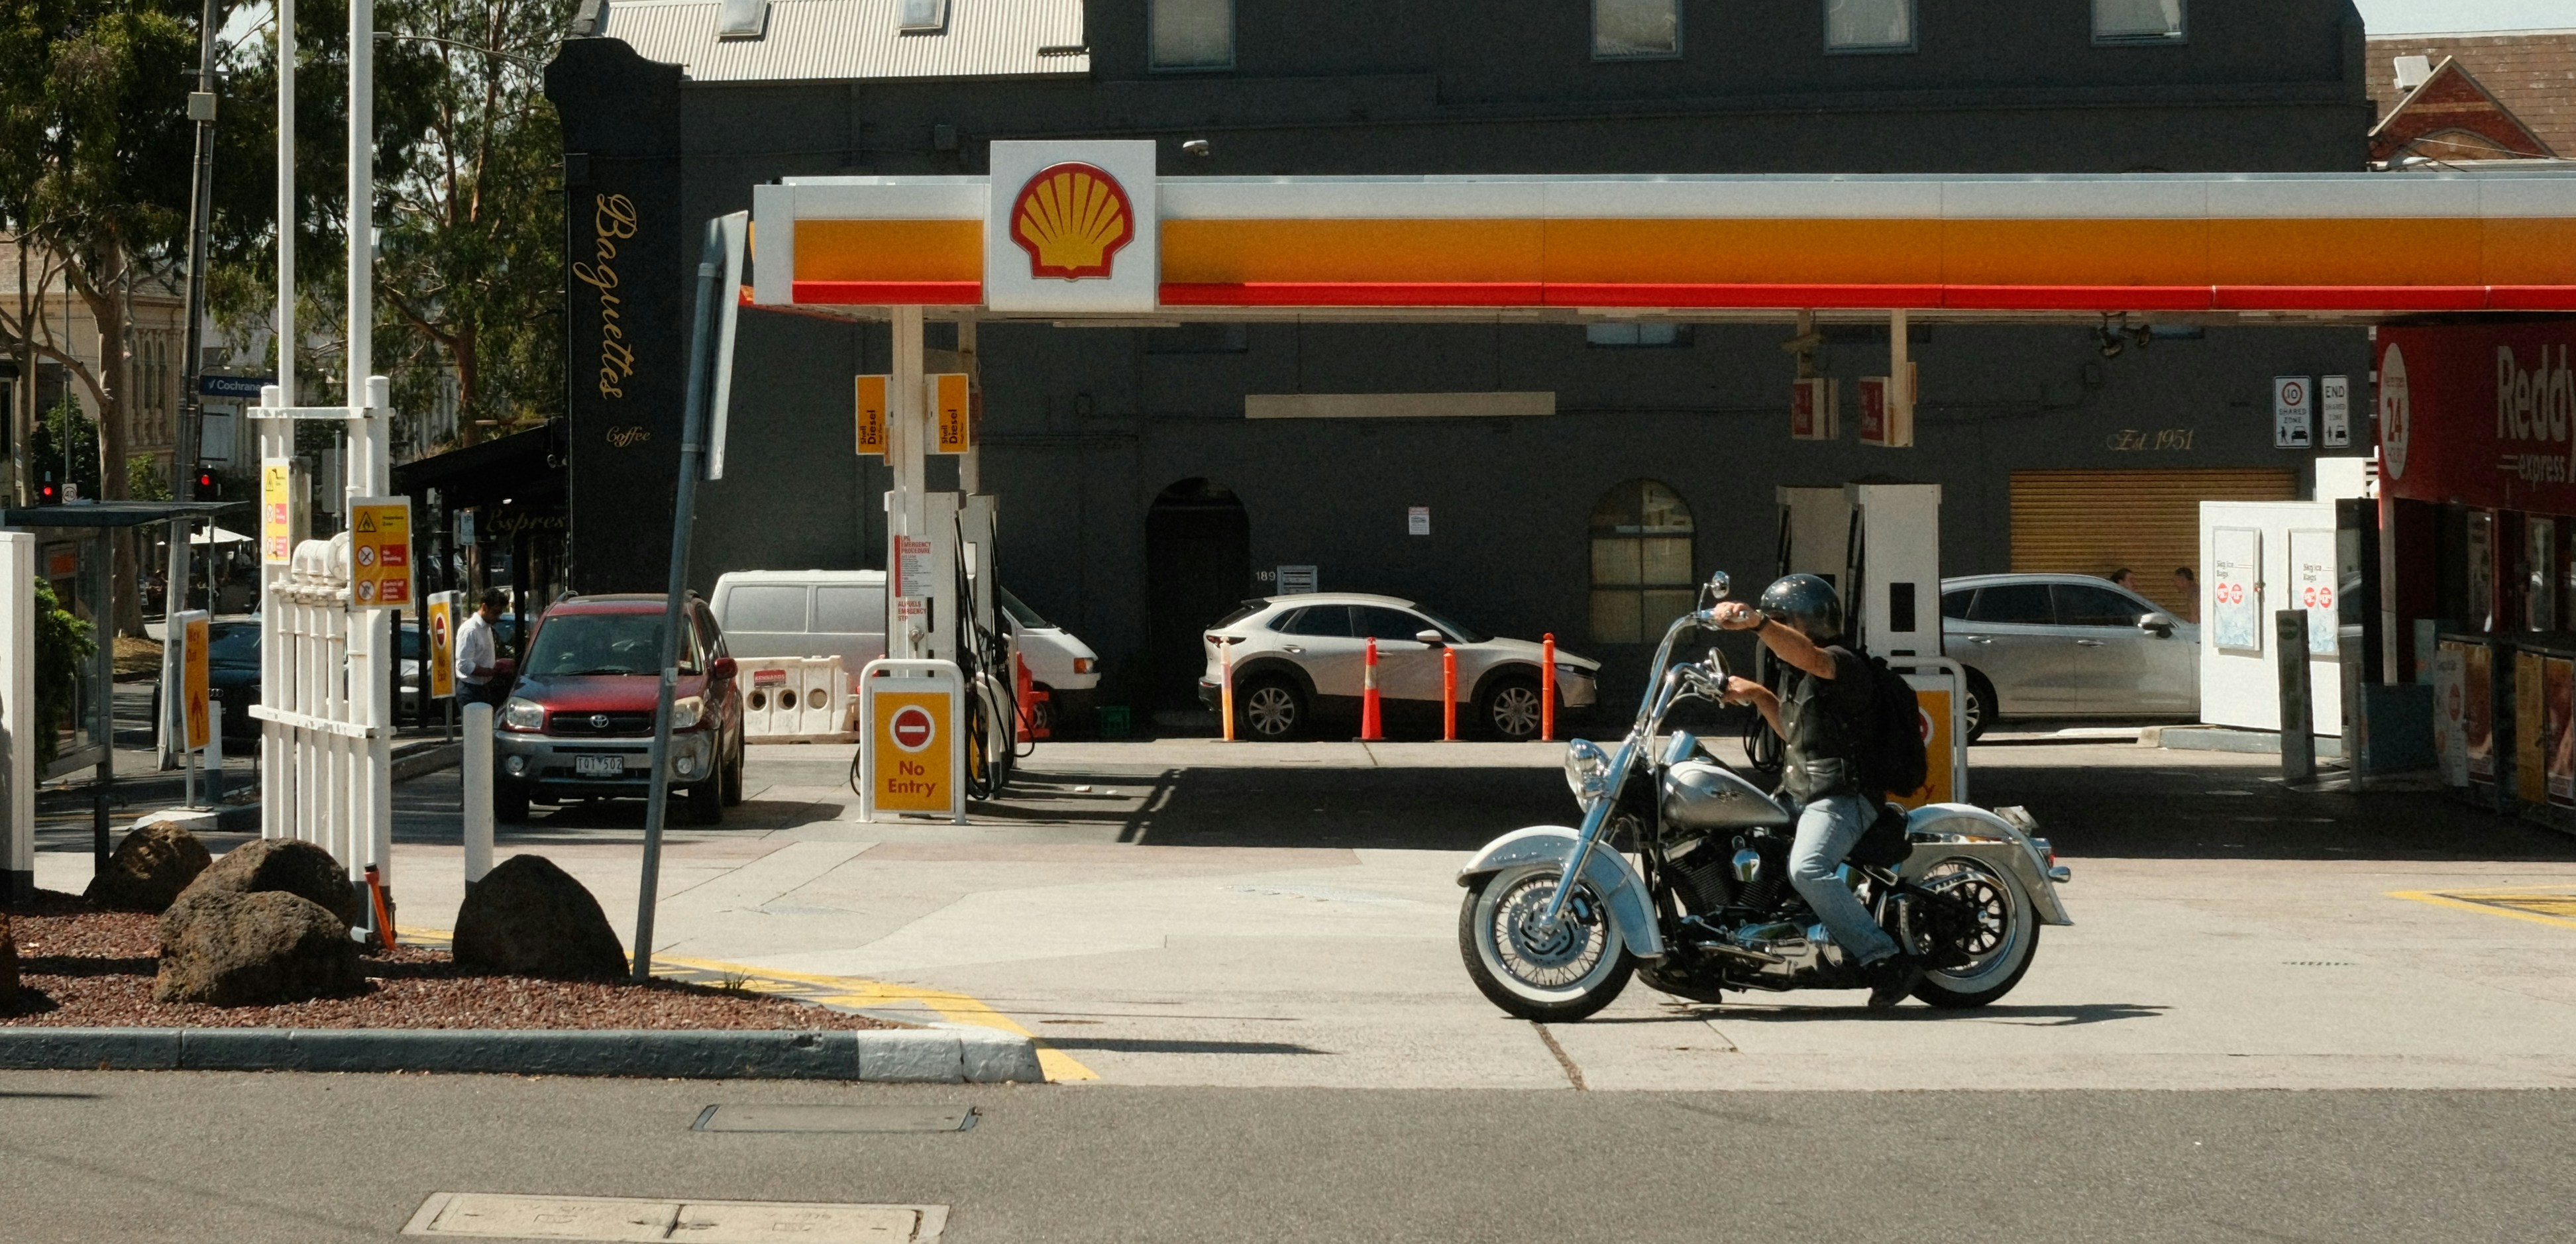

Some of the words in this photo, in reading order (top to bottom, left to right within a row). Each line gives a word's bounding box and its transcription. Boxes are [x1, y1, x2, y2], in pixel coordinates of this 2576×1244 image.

[573, 193, 637, 399] Baguettes
[217, 380, 261, 391] Cochrane
[2286, 389, 2298, 399] 10
[2325, 386, 2345, 397] END
[867, 409, 877, 444] Diesel
[947, 409, 958, 444] Diesel
[2387, 397, 2402, 442] 24
[606, 426, 651, 448] Coffee
[2154, 429, 2194, 450] 1951
[2519, 454, 2565, 493] express
[1256, 571, 1276, 581] 189
[899, 760, 925, 776] No
[888, 778, 936, 798] Entry
